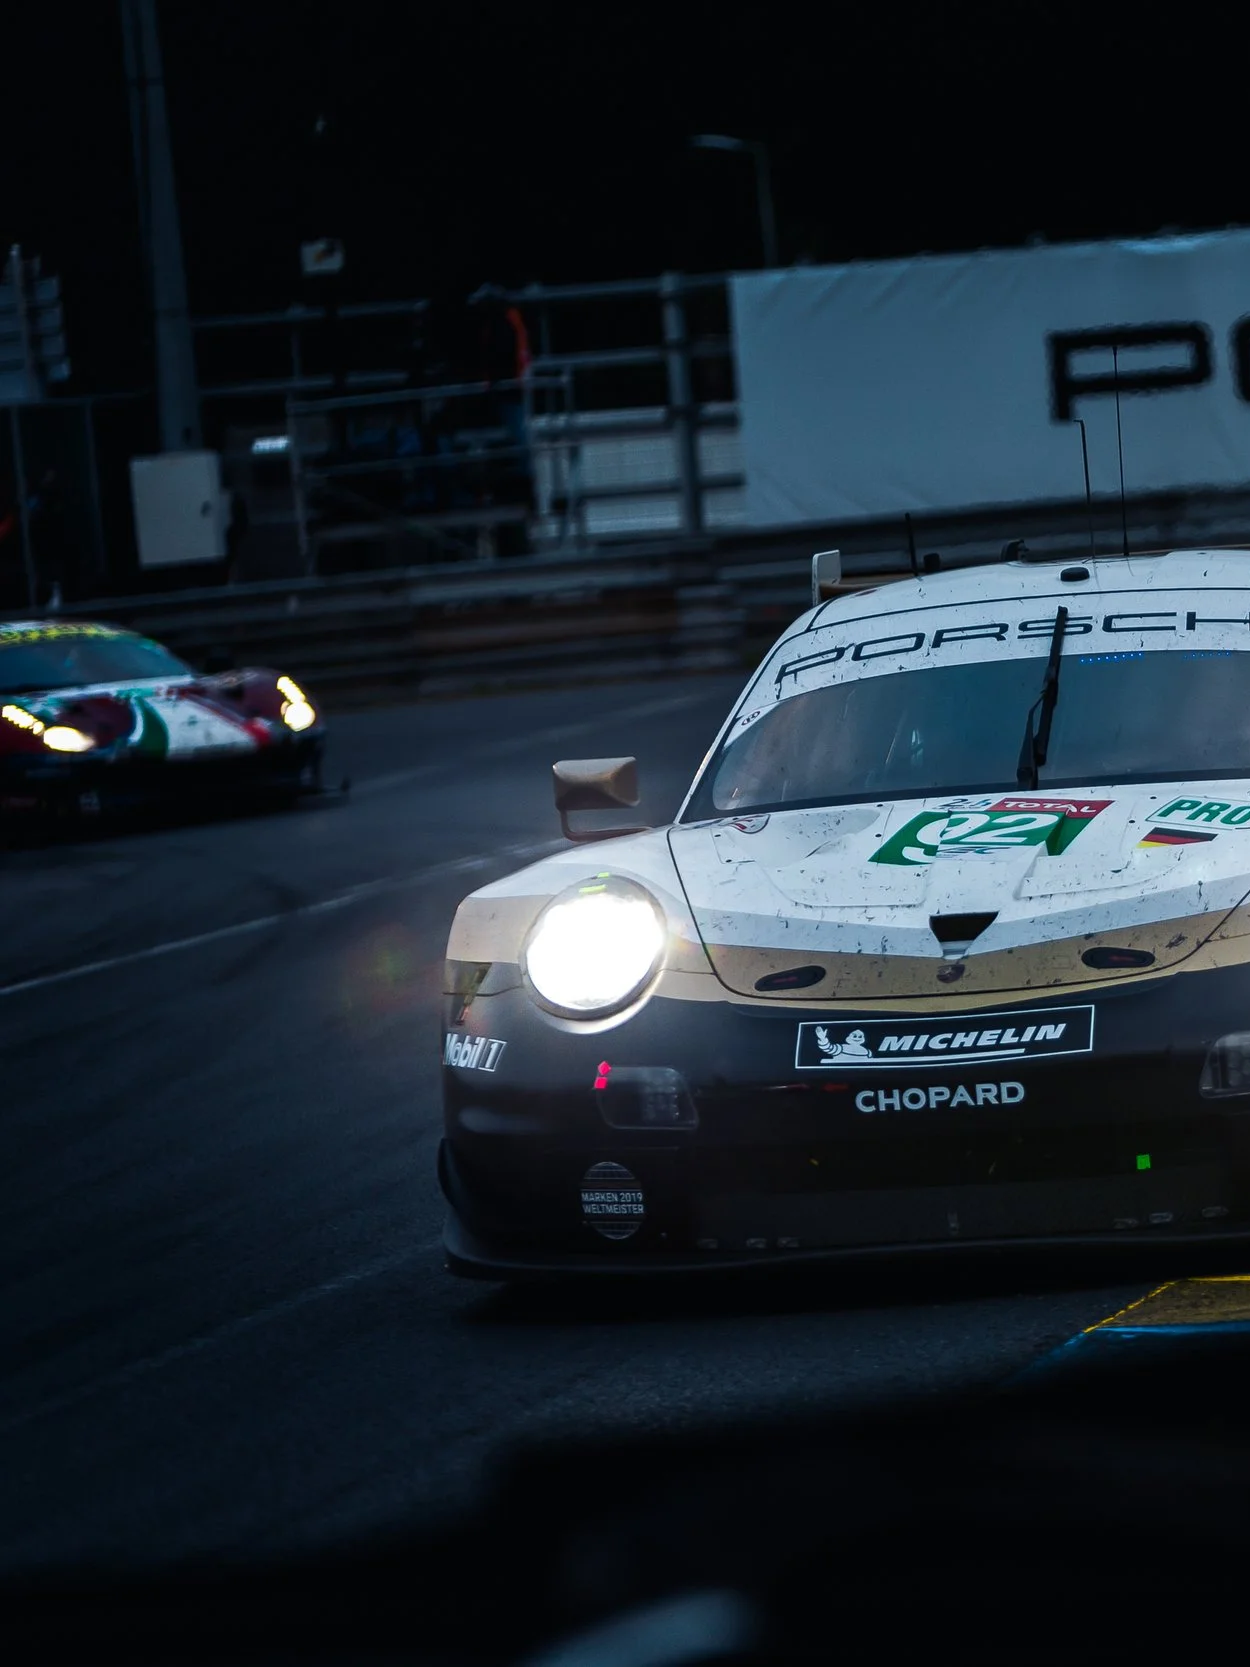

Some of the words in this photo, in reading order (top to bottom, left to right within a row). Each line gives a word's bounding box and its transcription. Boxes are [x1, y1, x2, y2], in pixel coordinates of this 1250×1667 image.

[1003, 801, 1097, 813] TOTAL
[901, 812, 1060, 864] 92
[443, 1033, 485, 1068] Mobil
[878, 1023, 1067, 1052] MICHELIN
[855, 1081, 1025, 1113] CHOPARD
[581, 1192, 618, 1202] MARKEN
[619, 1192, 643, 1202] 2019
[581, 1204, 644, 1214] WELTMEISTER
